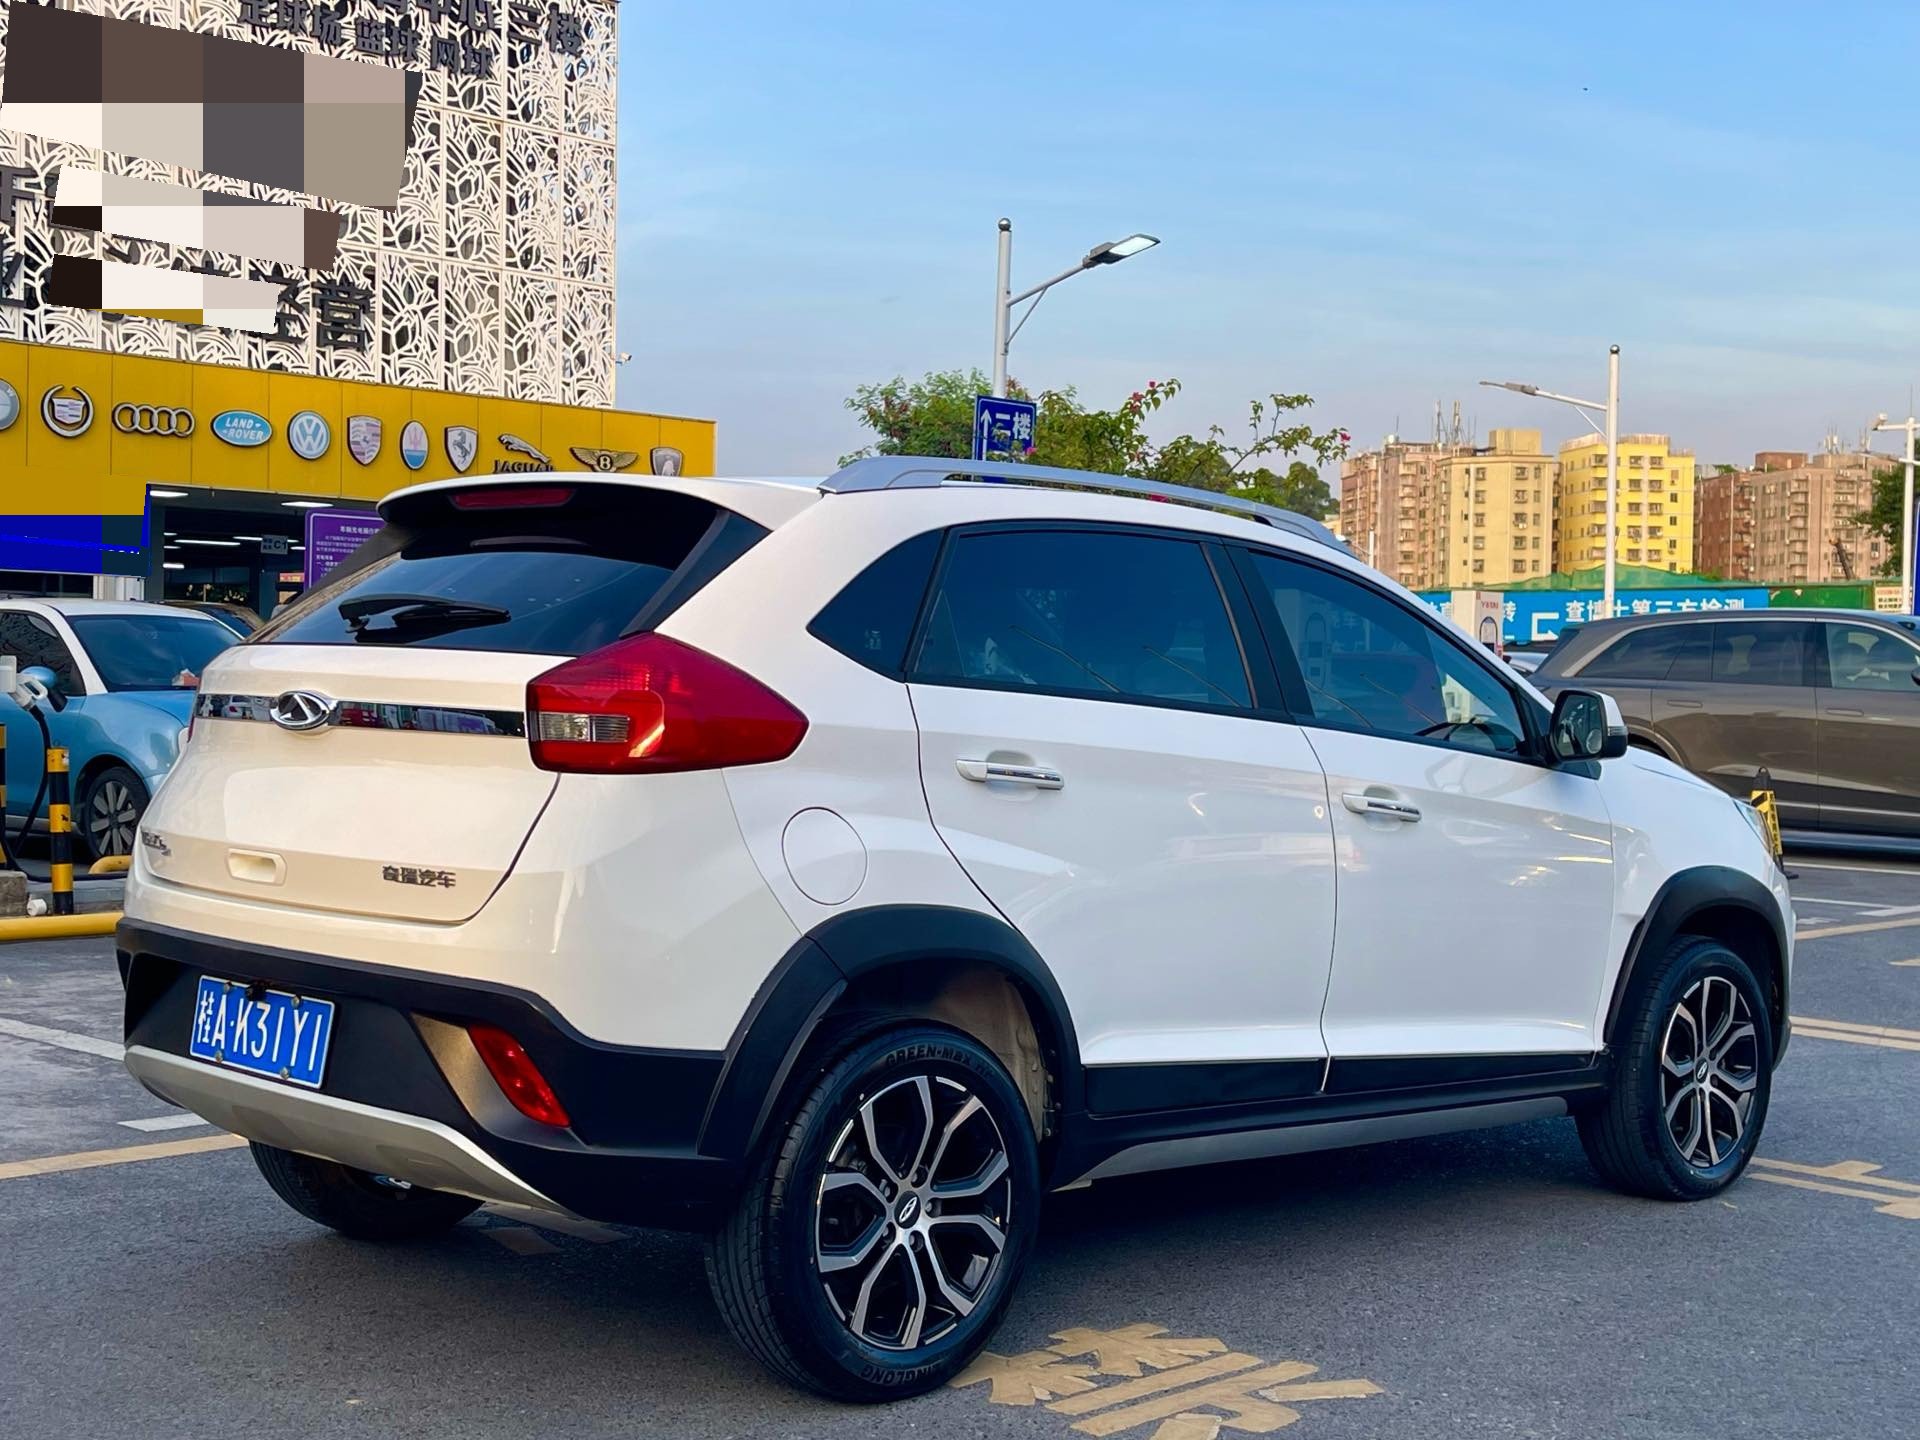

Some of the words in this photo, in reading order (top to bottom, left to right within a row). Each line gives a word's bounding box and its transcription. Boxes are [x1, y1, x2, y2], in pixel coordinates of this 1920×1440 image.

[225, 417, 254, 430] LAND
[228, 428, 264, 441] ROVER
[382, 865, 457, 888] 奇瑞汽车
